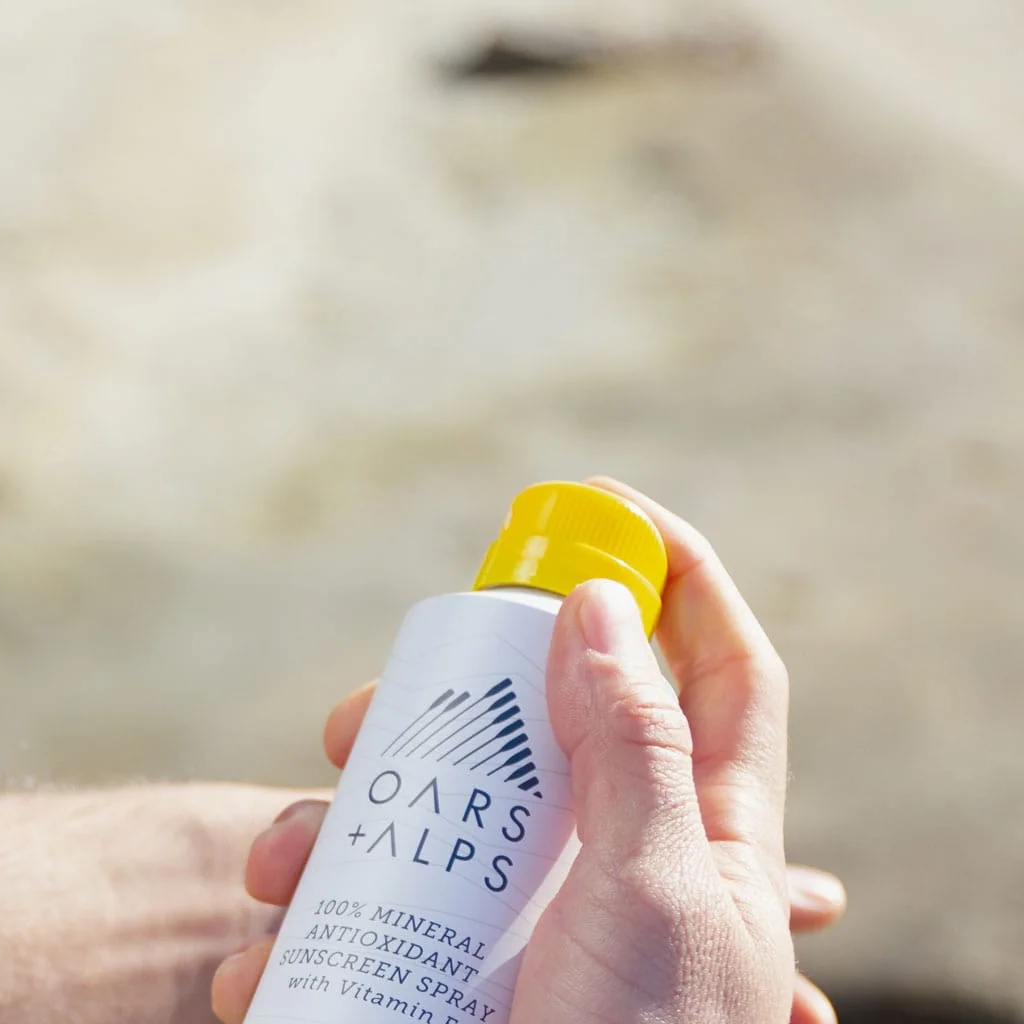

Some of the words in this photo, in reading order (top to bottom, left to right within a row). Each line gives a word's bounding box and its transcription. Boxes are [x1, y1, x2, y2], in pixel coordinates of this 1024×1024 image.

[368, 770, 531, 843] OARS
[305, 924, 479, 984] ANTIOXIDANT
[313, 899, 367, 918] 100%
[369, 906, 487, 961] MINERAL
[279, 949, 412, 985] SUNSCREEN
[416, 976, 496, 1023] SPRAY
[288, 974, 330, 992] with
[340, 979, 434, 1024] Vitamin
